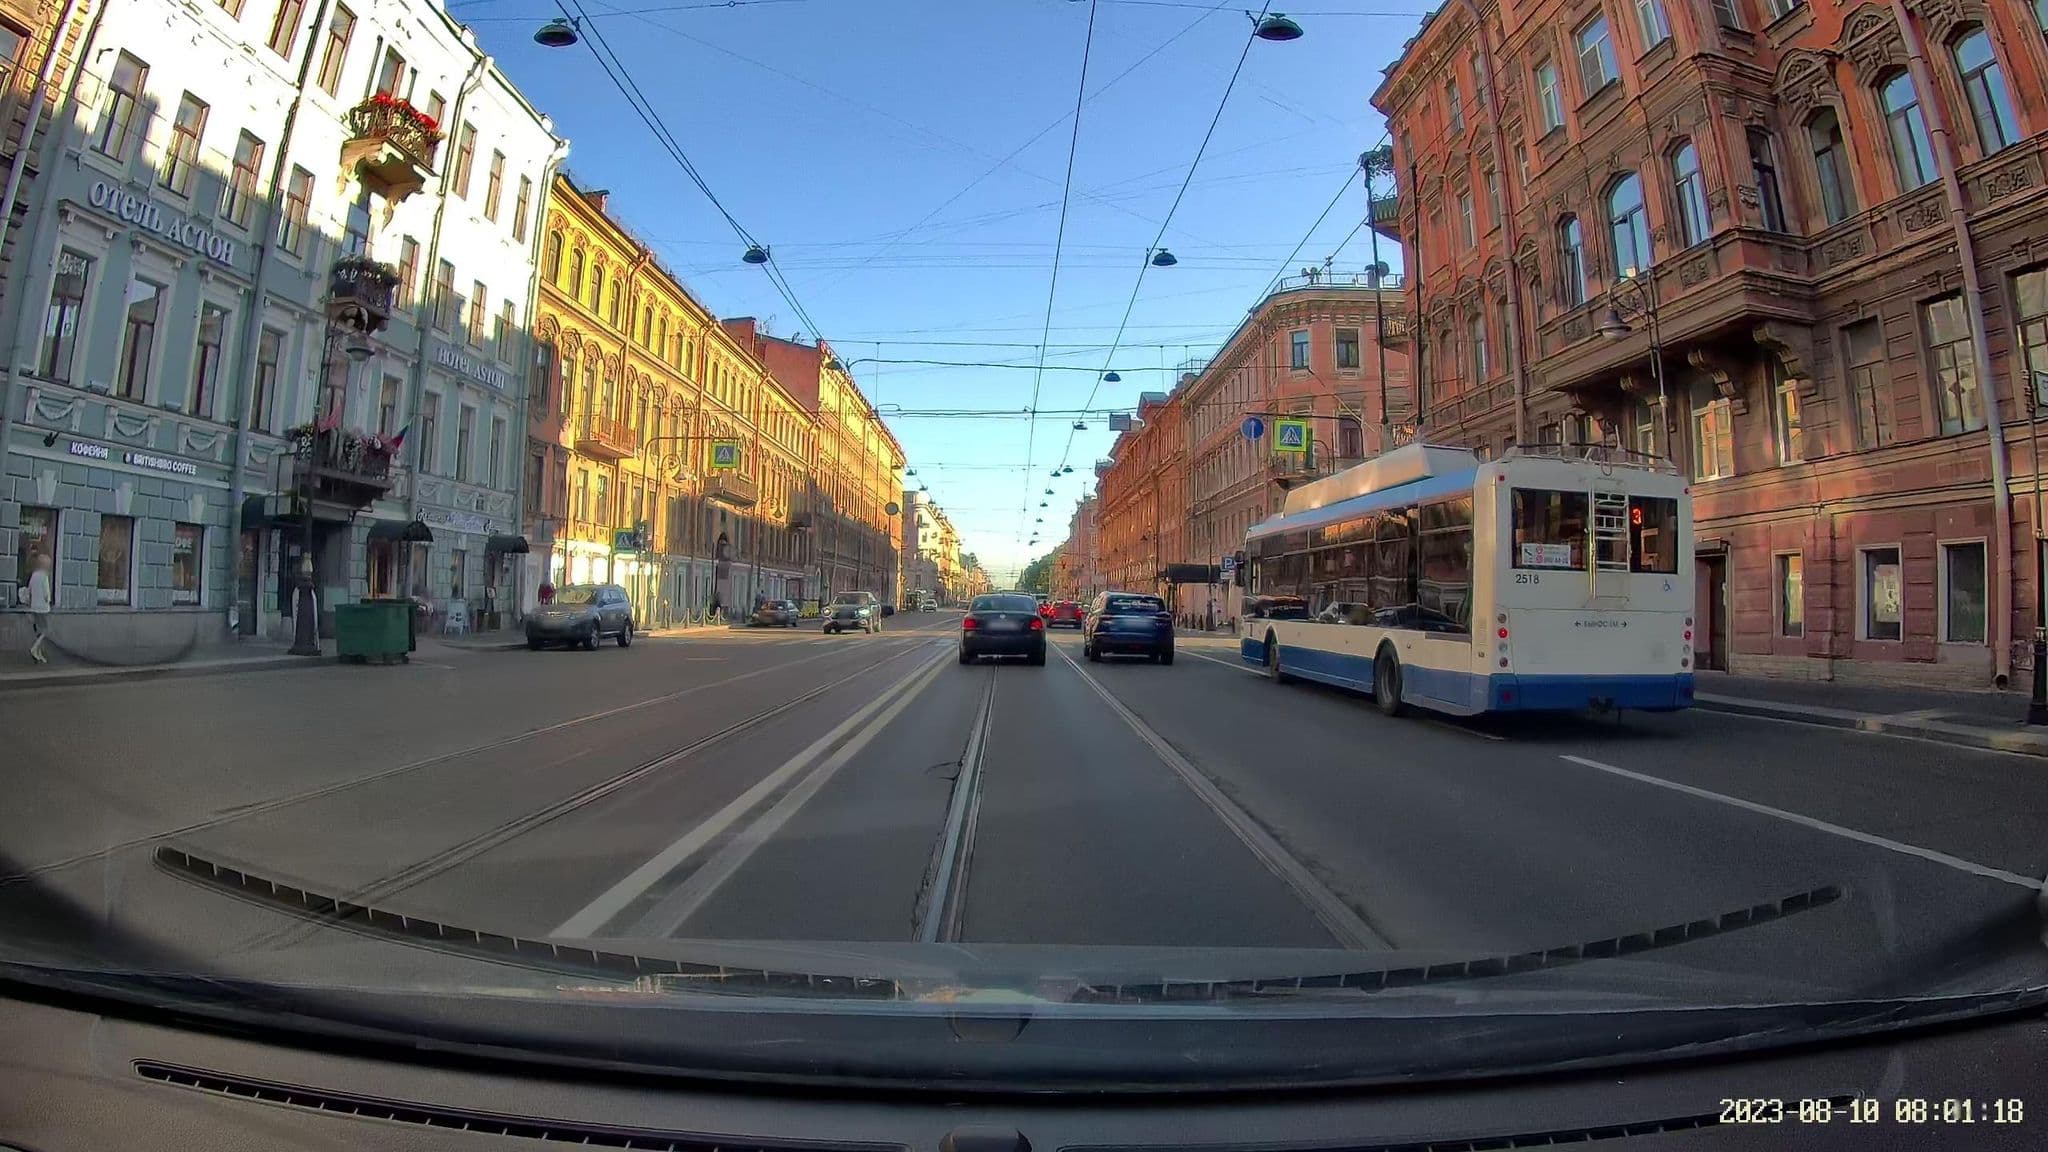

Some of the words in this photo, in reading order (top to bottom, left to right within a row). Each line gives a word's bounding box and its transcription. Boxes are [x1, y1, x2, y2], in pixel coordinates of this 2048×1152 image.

[166, 216, 235, 265] АСТОН
[71, 441, 109, 459] КОФЕЙНЯ
[1632, 508, 1642, 525] 3
[1515, 574, 1540, 584] 2518
